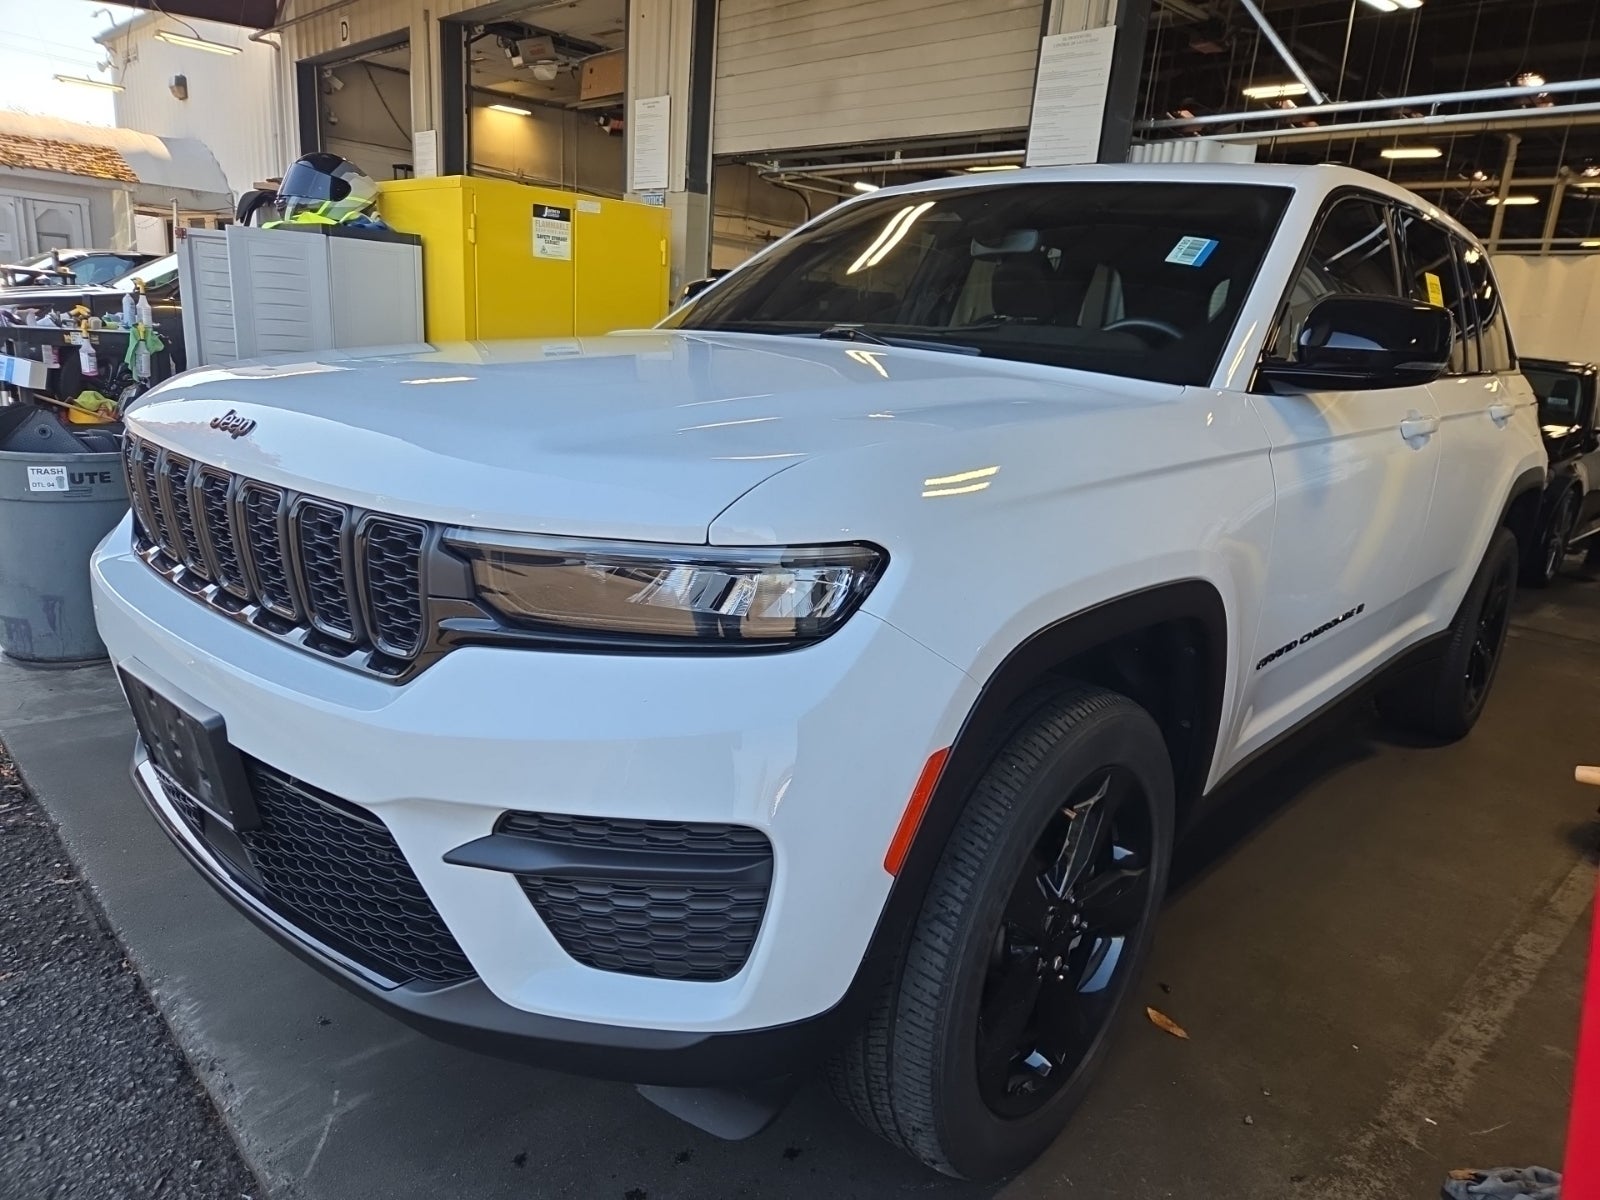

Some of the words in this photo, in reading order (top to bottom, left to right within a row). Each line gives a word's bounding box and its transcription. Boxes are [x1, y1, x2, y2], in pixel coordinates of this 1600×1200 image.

[341, 21, 349, 42] D
[535, 219, 569, 231] FLAMMABLE
[210, 409, 256, 440] Jeep
[69, 471, 112, 485] UTE
[1256, 639, 1299, 670] GRAND
